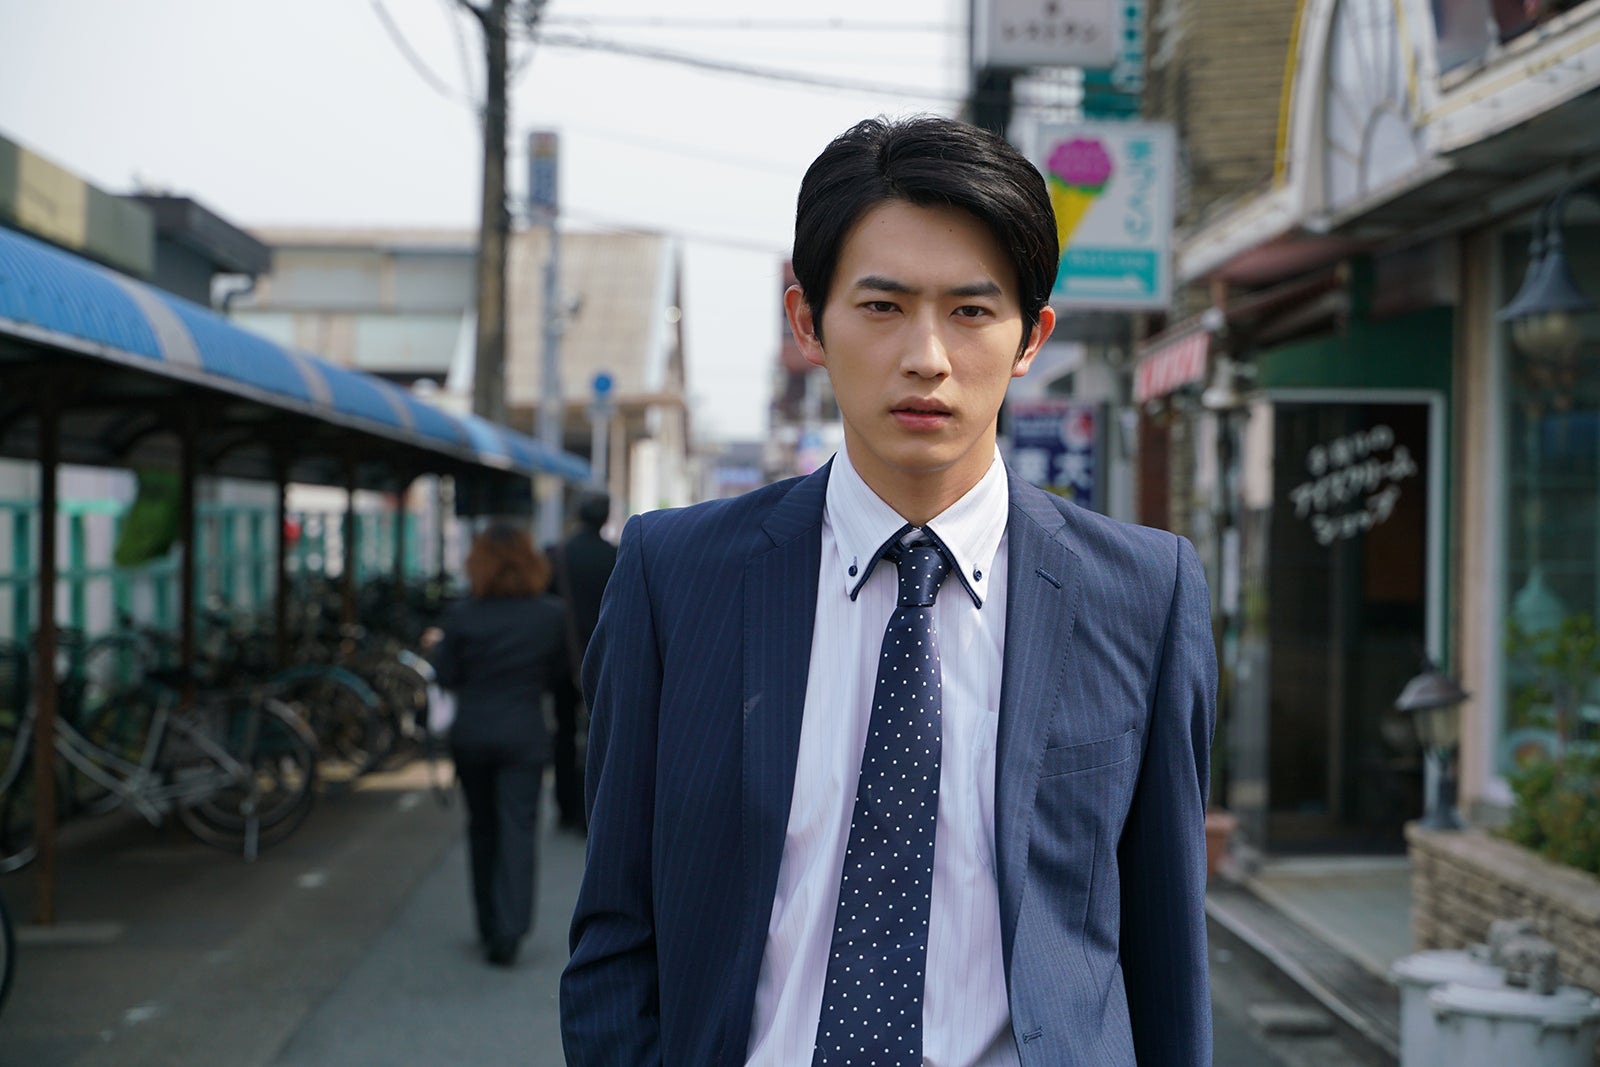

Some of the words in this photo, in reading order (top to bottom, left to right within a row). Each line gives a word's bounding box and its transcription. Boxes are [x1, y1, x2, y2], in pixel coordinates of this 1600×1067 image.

[1290, 446, 1416, 519] アイスクリーム
[1312, 485, 1400, 544] ショップ
